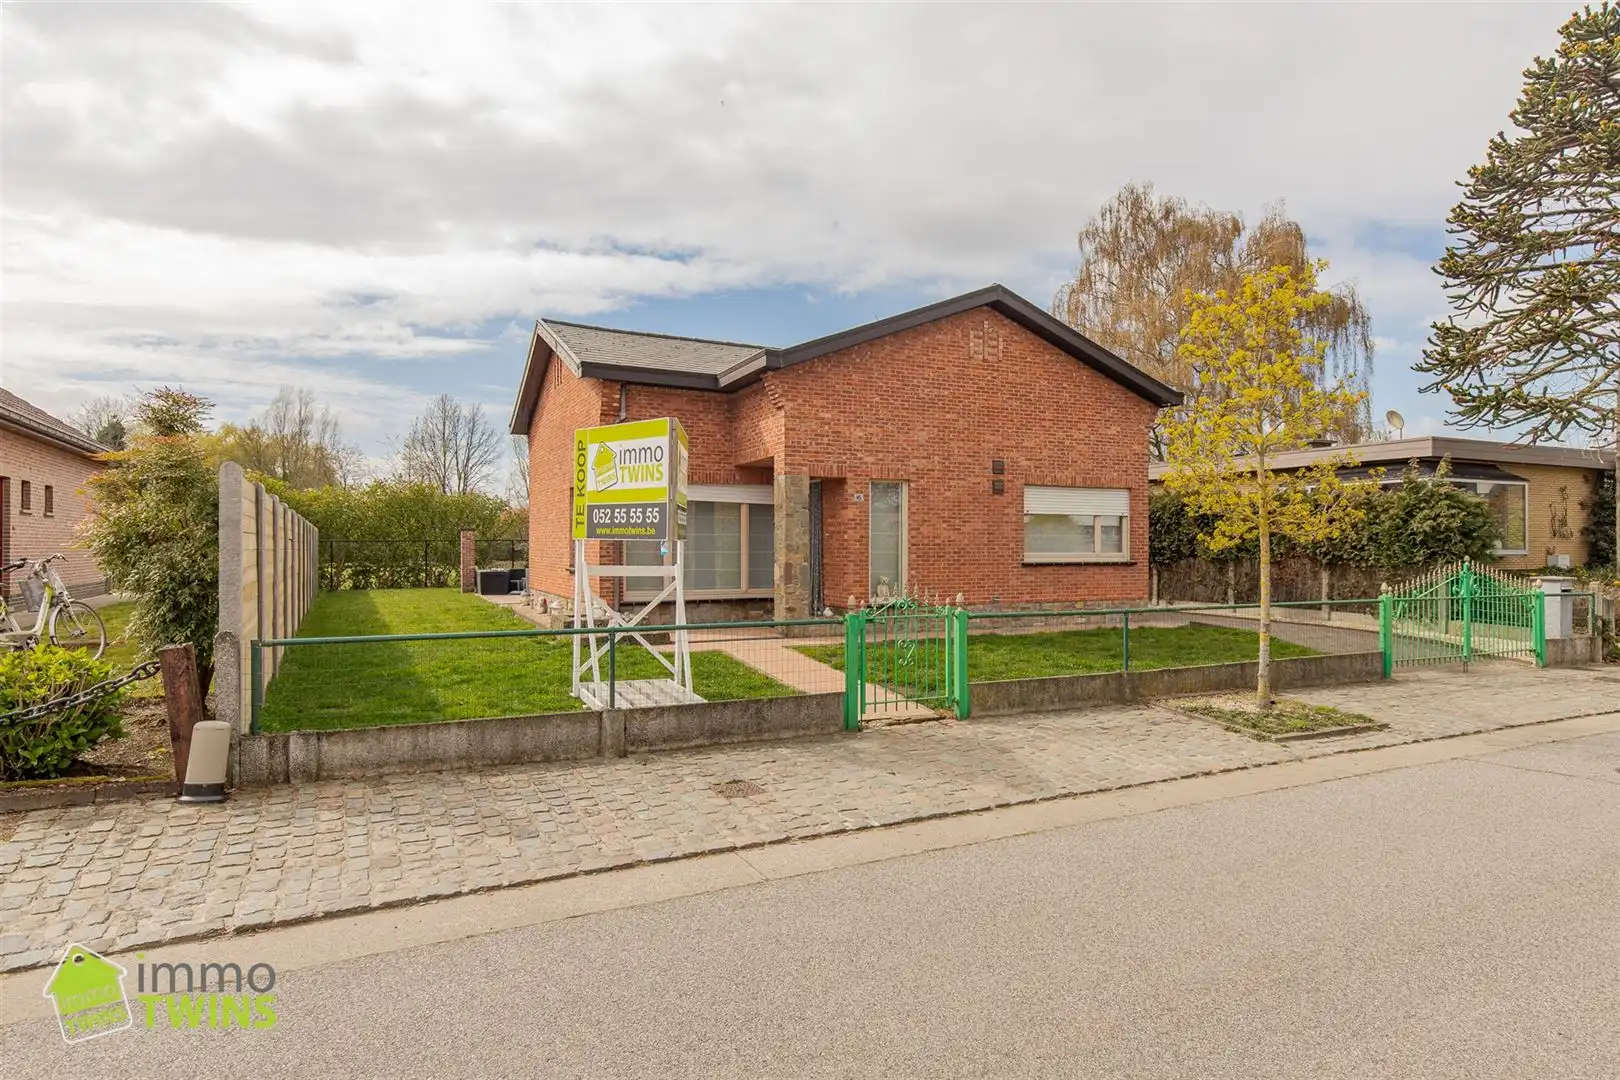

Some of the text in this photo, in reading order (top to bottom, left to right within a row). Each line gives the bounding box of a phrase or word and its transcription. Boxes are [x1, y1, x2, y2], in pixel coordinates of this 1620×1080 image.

[619, 444, 664, 465] immo
[619, 463, 664, 483] TWINS
[575, 440, 586, 529] TE KOOP
[592, 508, 612, 524] 052
[613, 509, 628, 524] 55
[629, 508, 643, 524] 55
[645, 507, 660, 523] 55
[595, 526, 656, 536] www.immotwins.be
